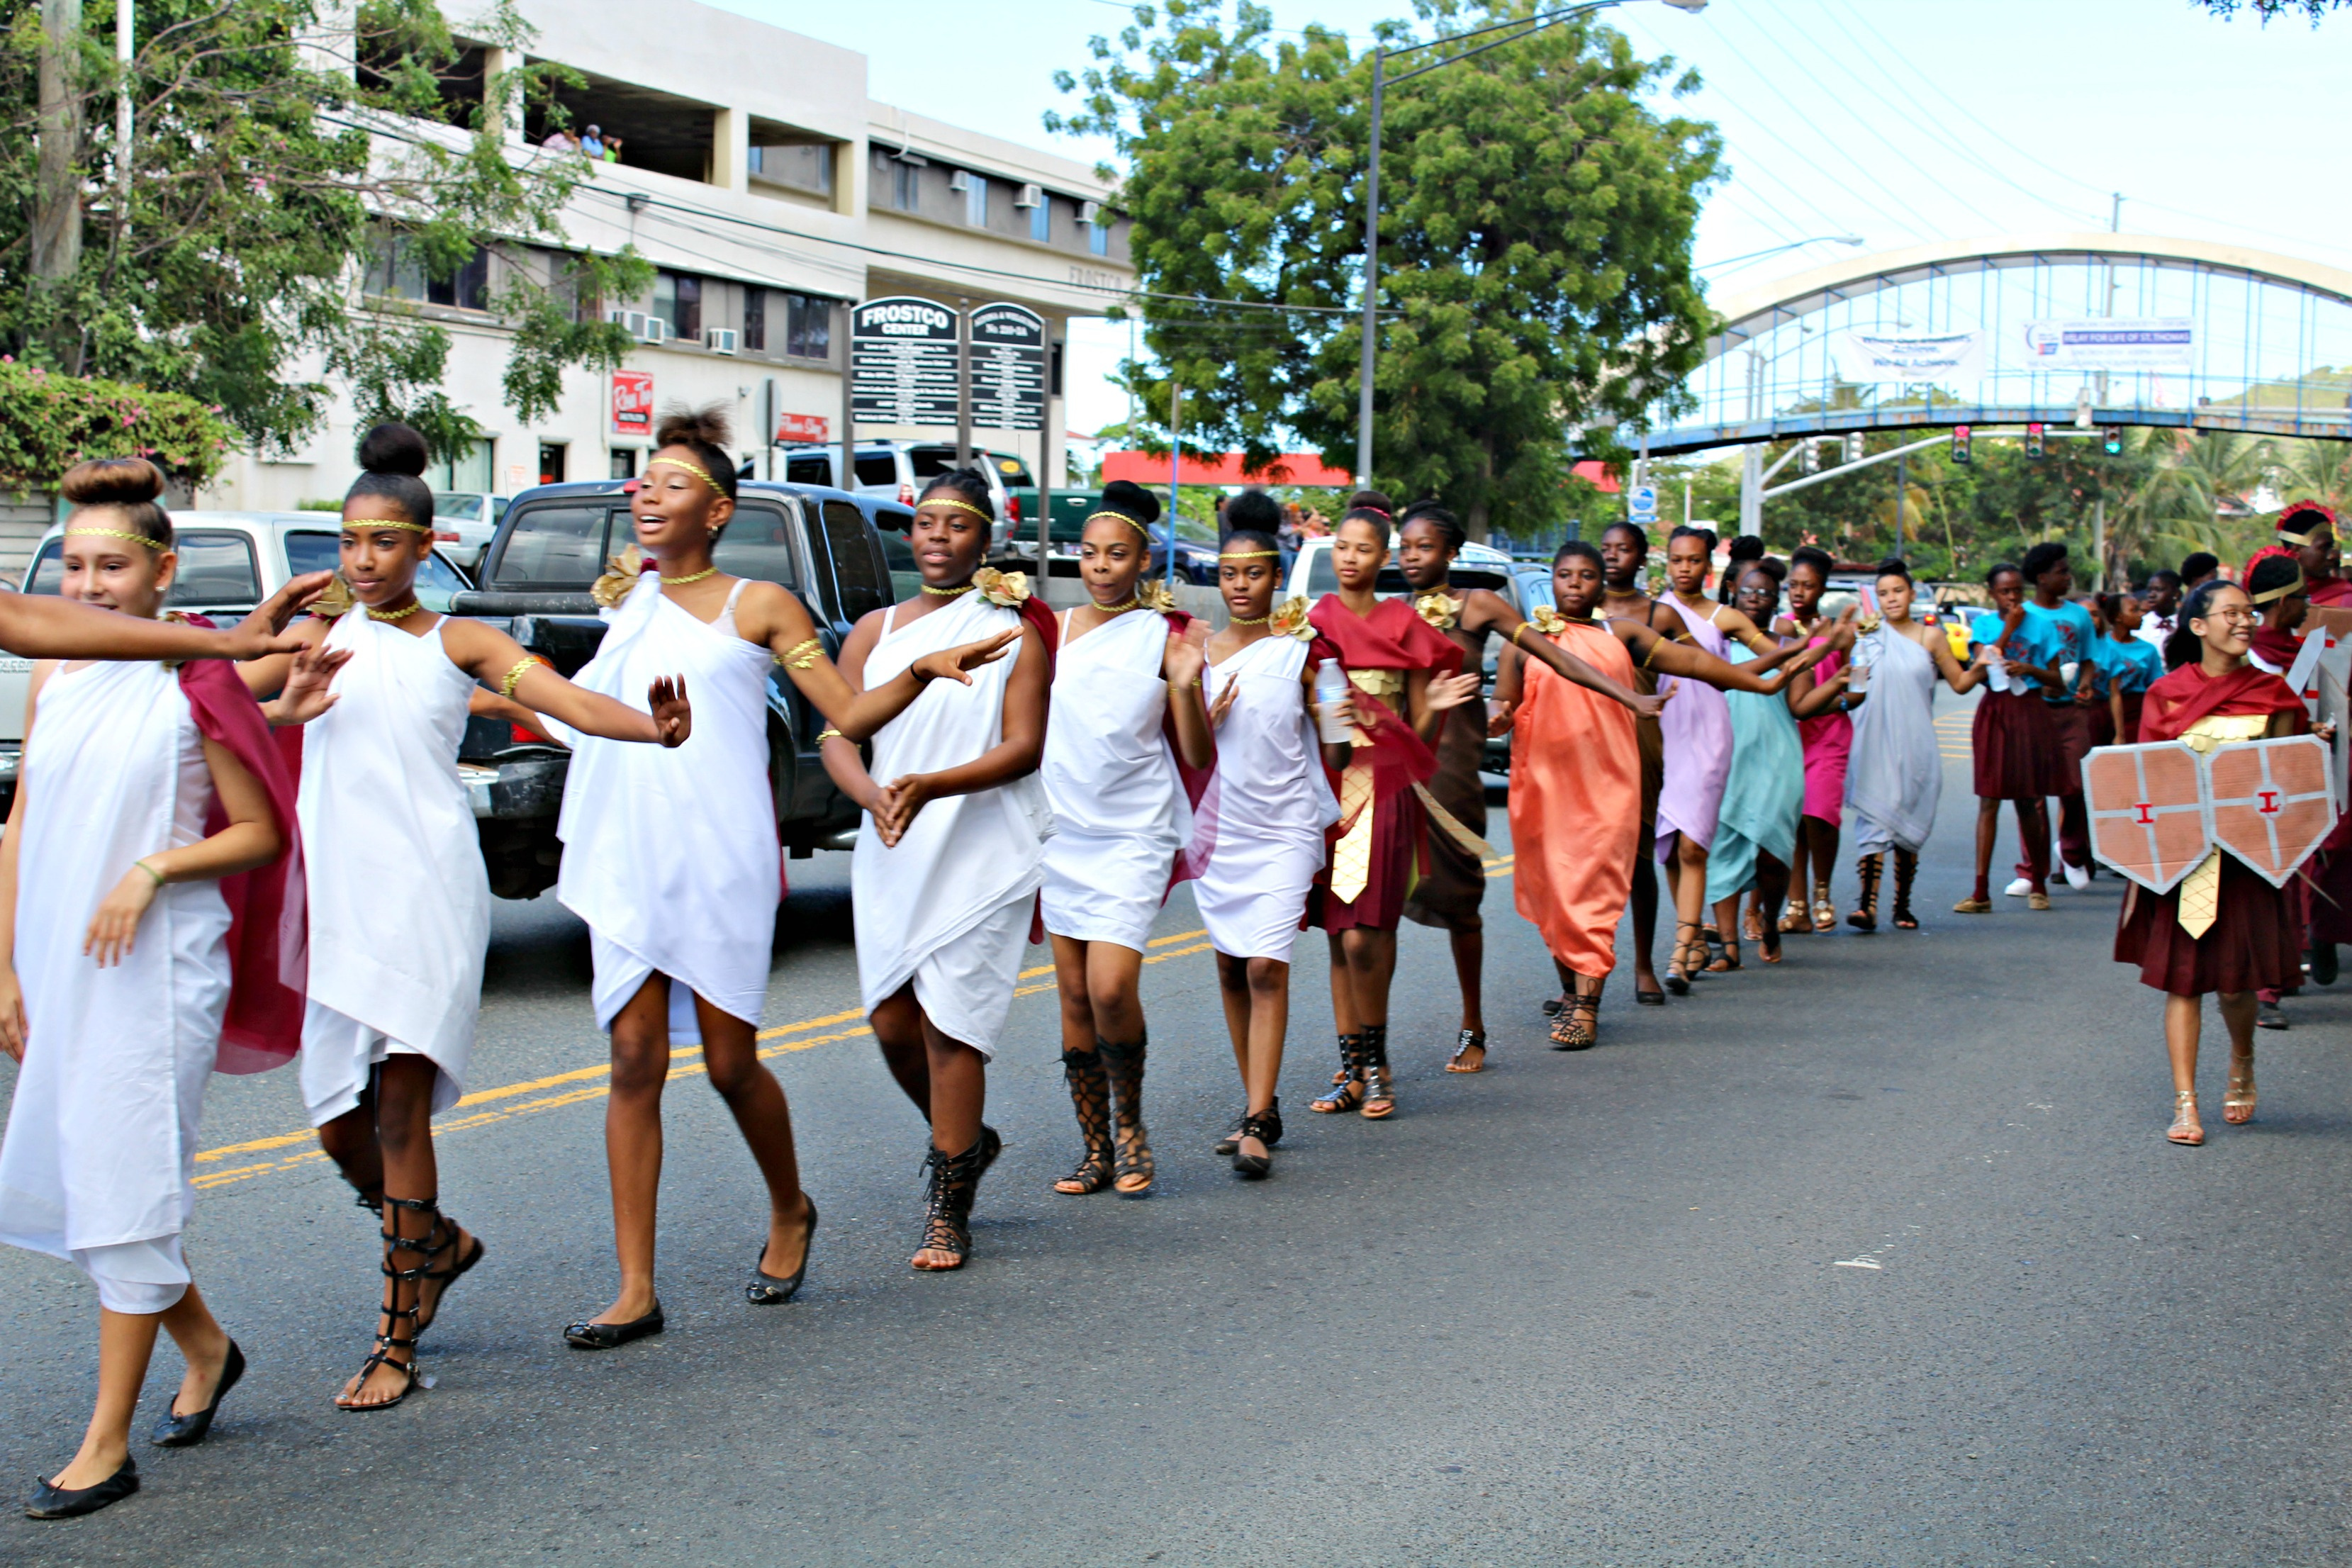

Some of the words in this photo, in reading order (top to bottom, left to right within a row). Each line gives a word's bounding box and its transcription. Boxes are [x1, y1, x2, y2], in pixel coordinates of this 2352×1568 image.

[862, 305, 948, 329] FROSTCO
[882, 323, 929, 336] CENTER
[2063, 332, 2088, 342] RELAY
[2090, 332, 2107, 342] FOR
[2109, 332, 2126, 342] LIFE
[2127, 332, 2139, 342] OF
[2154, 331, 2190, 342] THOMAS
[2258, 792, 2278, 813] I
[2134, 803, 2154, 824] I
